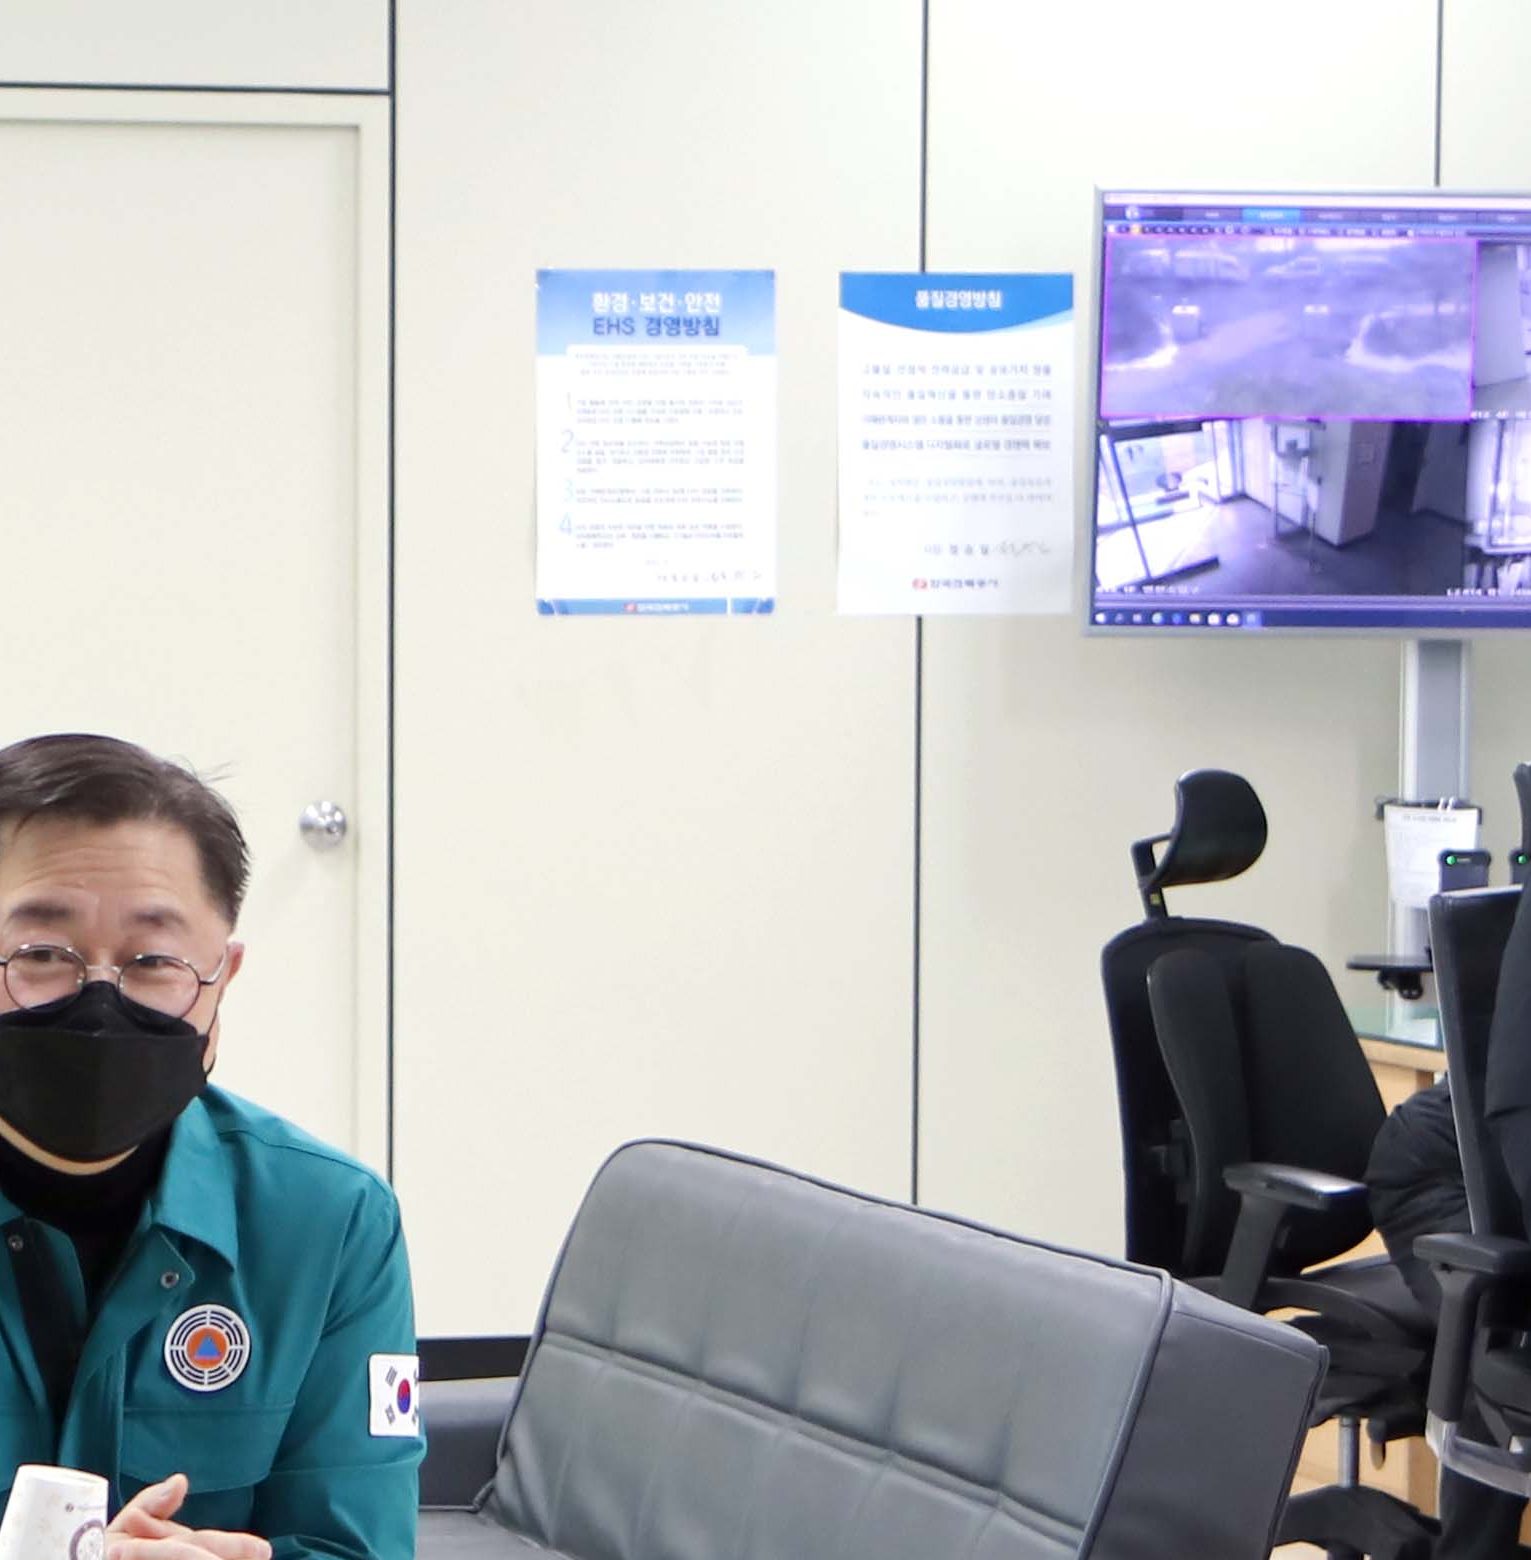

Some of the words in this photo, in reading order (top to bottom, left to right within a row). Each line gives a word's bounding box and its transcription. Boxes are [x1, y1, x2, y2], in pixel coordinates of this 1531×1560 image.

[916, 290, 1002, 309] 품질경영방침
[593, 317, 635, 335] EHS
[645, 316, 720, 336] 경영방침
